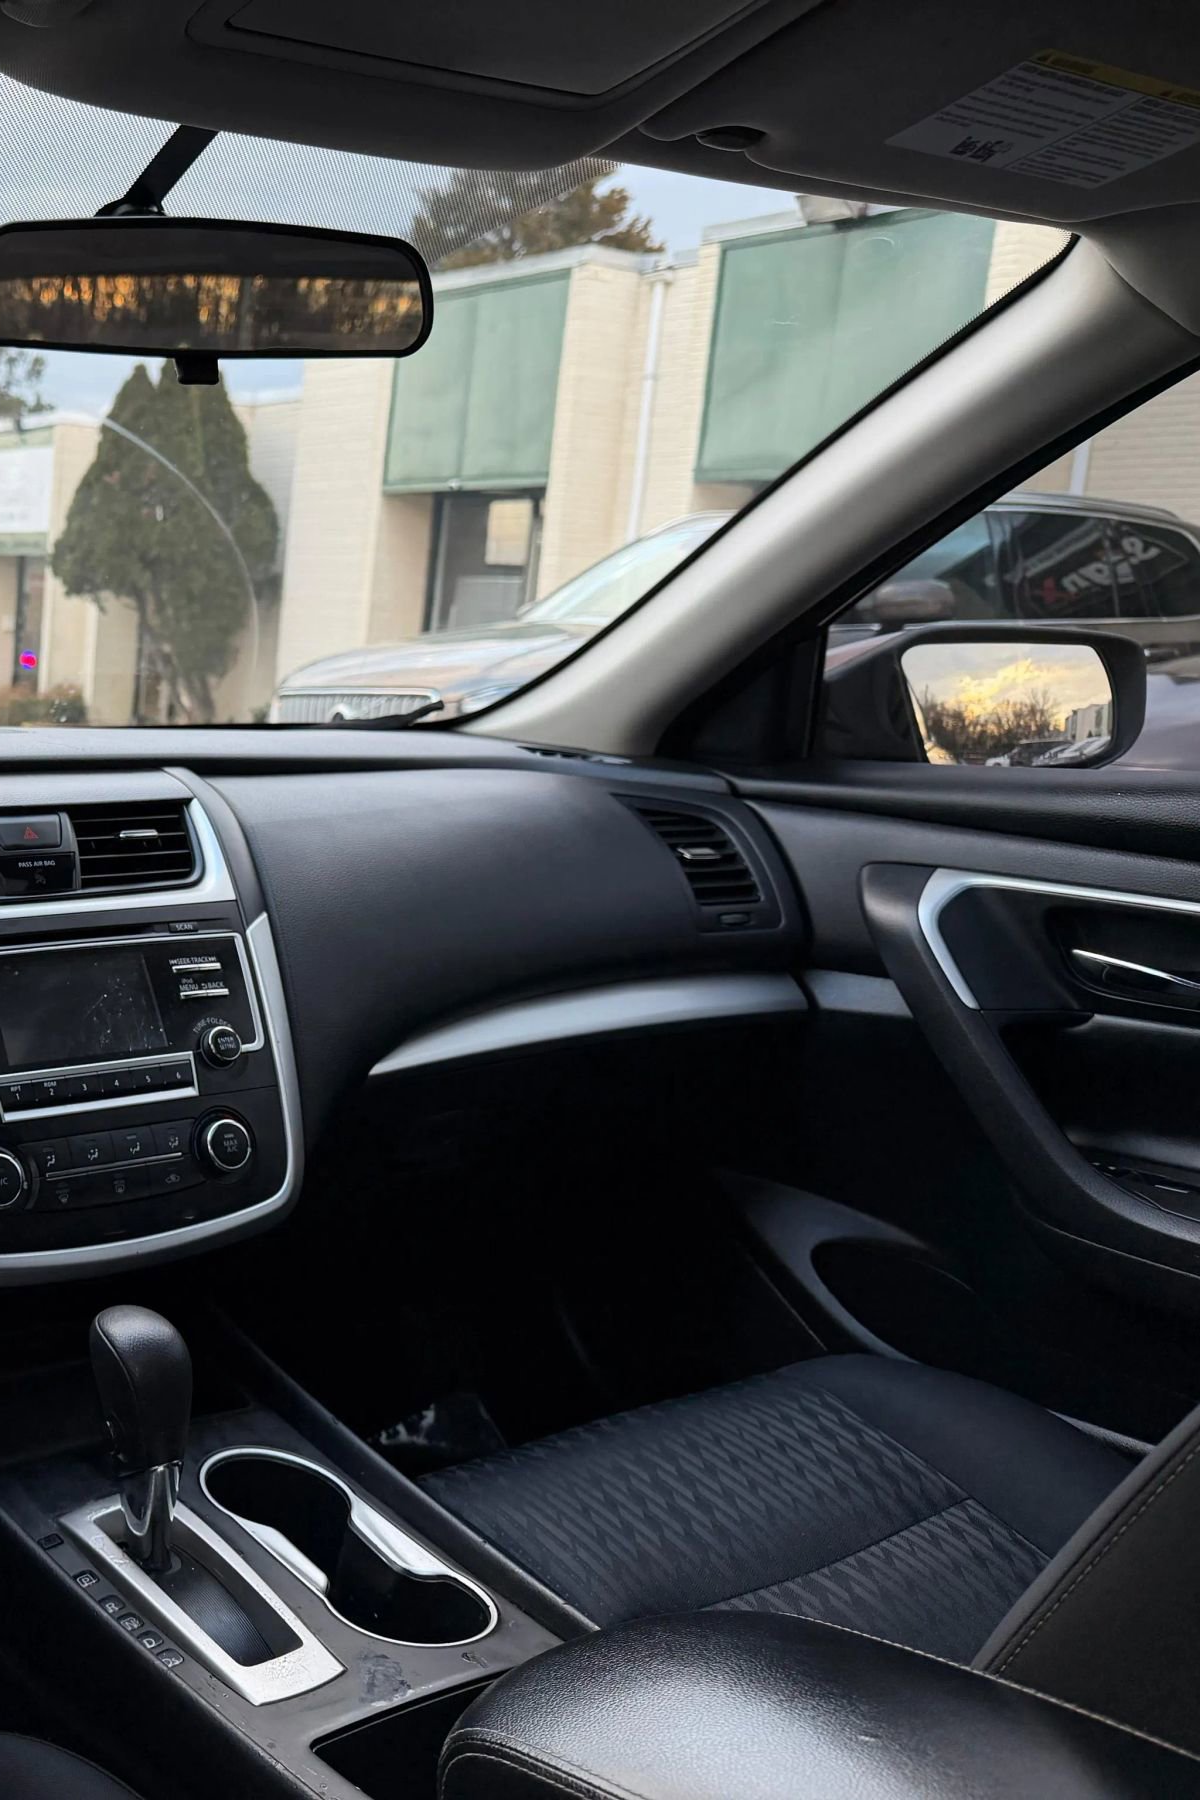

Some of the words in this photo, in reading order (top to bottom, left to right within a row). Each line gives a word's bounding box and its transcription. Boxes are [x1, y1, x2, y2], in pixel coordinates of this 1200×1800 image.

[175, 923, 193, 931] SCAN
[207, 981, 224, 989] BACK
[145, 1075, 151, 1083] 5
[82, 1083, 88, 1091] 3
[49, 1088, 55, 1096] 2
[105, 1602, 119, 1613] R
[143, 1638, 155, 1648] D
